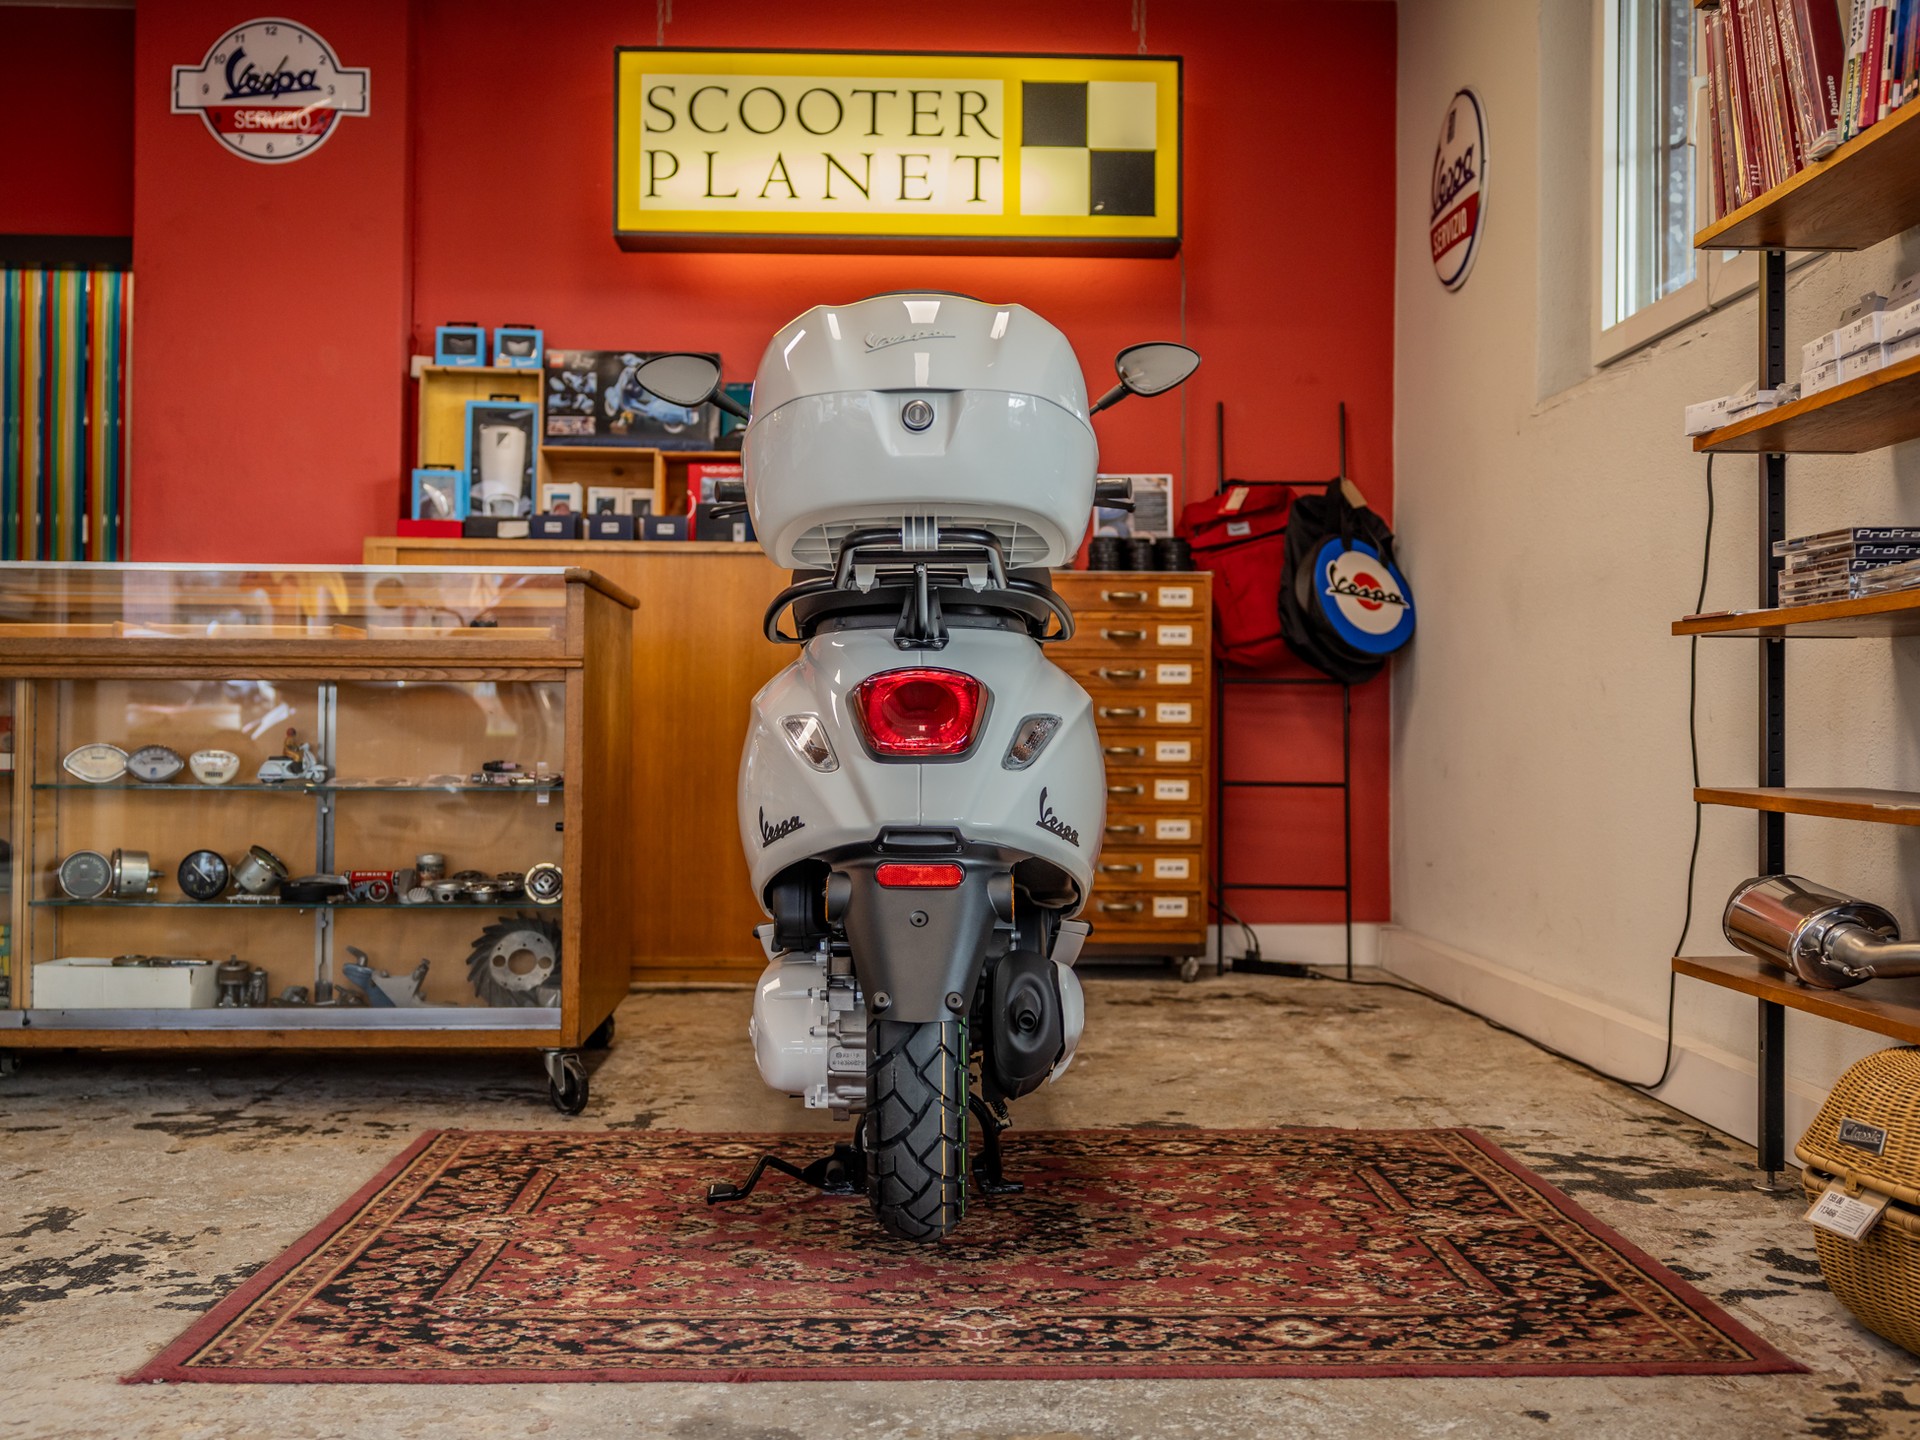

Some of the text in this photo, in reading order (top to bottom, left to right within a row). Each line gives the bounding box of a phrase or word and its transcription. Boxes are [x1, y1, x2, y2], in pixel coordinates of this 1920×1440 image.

[235, 34, 245, 43] 11
[265, 26, 277, 35] 12
[298, 35, 303, 43] 1
[214, 55, 226, 64] 10
[319, 55, 327, 65] 2
[222, 46, 322, 100] Vespa
[202, 85, 209, 94] 9
[328, 85, 335, 95] 3
[1827, 75, 1839, 116] Derivate
[234, 110, 312, 131] SERVIZIO
[644, 85, 1000, 140] SCOOTER
[237, 134, 244, 145] 7
[266, 142, 274, 154] 6
[296, 135, 304, 146] 5
[644, 148, 1000, 203] PLANET
[1431, 143, 1476, 224] Vespa
[1433, 207, 1468, 256] SERVIZIO
[1329, 562, 1410, 608] Vespa
[759, 806, 805, 849] Vespa
[1036, 786, 1080, 848] Vespa
[1841, 1122, 1883, 1145] Classic
